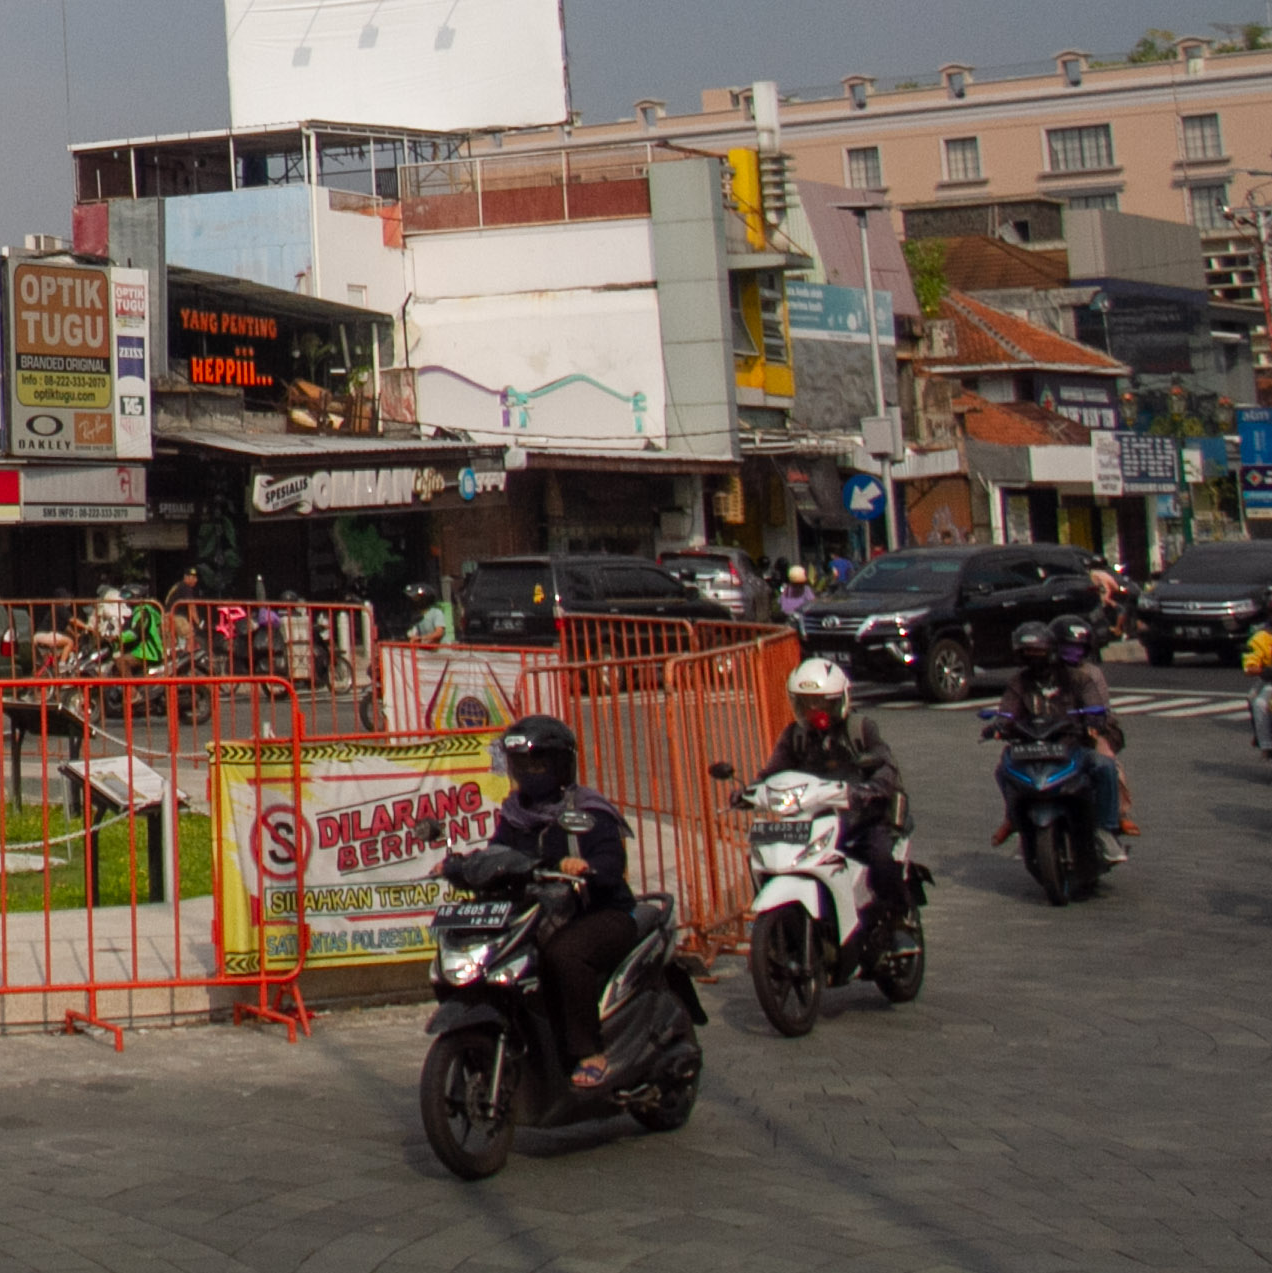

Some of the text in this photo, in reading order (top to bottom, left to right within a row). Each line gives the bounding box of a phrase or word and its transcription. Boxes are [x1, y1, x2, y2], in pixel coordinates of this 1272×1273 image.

[21, 274, 104, 310] OPTIK
[115, 287, 144, 299] OPTIK
[115, 299, 145, 312] TUGU
[22, 311, 105, 348] TUGU
[180, 308, 278, 340] YANG PENTING
[118, 347, 144, 359] ZEISS
[21, 355, 107, 373] BRANDED ORIGINAL
[33, 388, 96, 404] optiktugu.com
[122, 397, 143, 415] TAG
[18, 439, 71, 451] OAKLEY
[265, 477, 308, 504] SPESIALIS
[316, 781, 483, 850] DILARANG
[375, 883, 440, 909] TETAP
[437, 906, 454, 917] AB
[351, 926, 426, 950] POLRESTA
